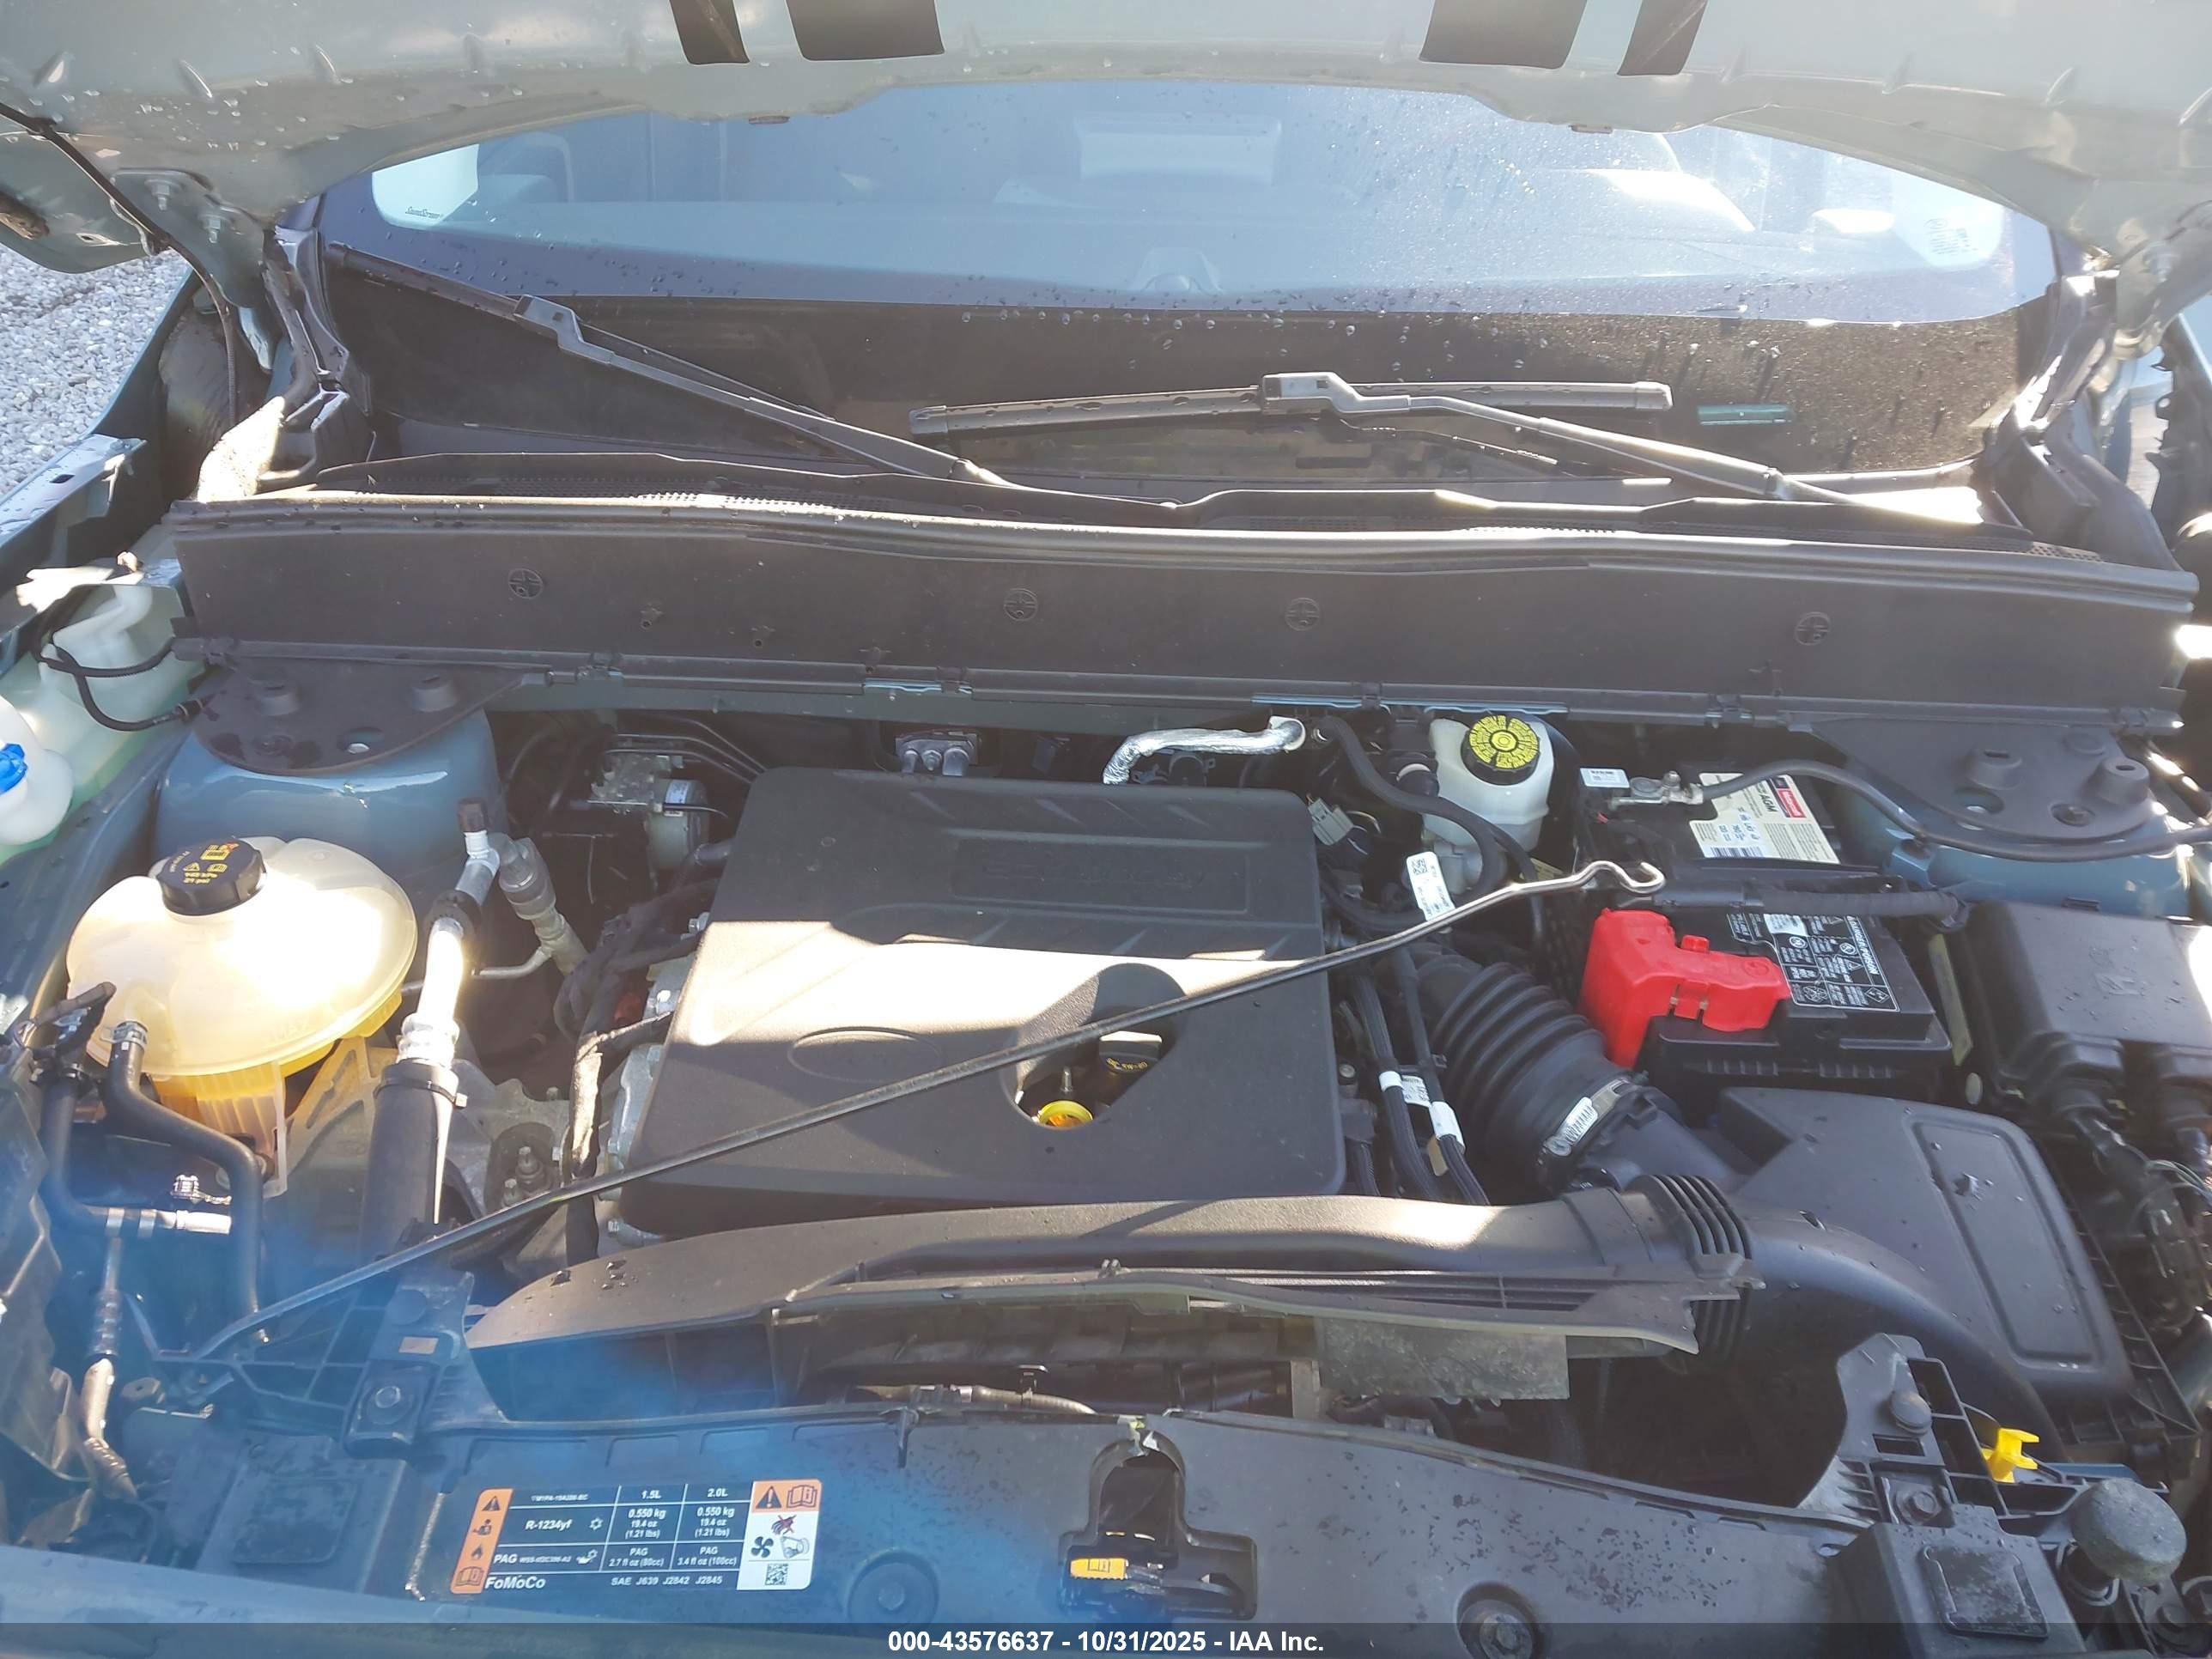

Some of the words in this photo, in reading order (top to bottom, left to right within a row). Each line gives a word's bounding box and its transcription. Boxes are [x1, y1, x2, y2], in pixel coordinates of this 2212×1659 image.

[1759, 793, 1778, 812] AGM
[641, 1489, 662, 1499] 1.5L
[707, 1488, 728, 1498] 2.0L
[628, 1509, 653, 1519] 0.550
[653, 1508, 667, 1520] kg
[696, 1507, 722, 1516] 0.550
[722, 1506, 735, 1518] kg
[525, 1519, 574, 1532] R-1234yf
[625, 1529, 645, 1540] (1.21
[695, 1528, 714, 1539] (1.21
[629, 1547, 649, 1556] PAG
[699, 1547, 720, 1555] PAG
[493, 1553, 519, 1565] PAG
[609, 1558, 622, 1567] 2.7
[677, 1557, 690, 1566] 3.4
[484, 1576, 546, 1589] FoMoCo
[611, 1577, 632, 1586] SAE
[635, 1577, 659, 1586] J639
[662, 1576, 690, 1586] J2842
[695, 1576, 723, 1585] J2845
